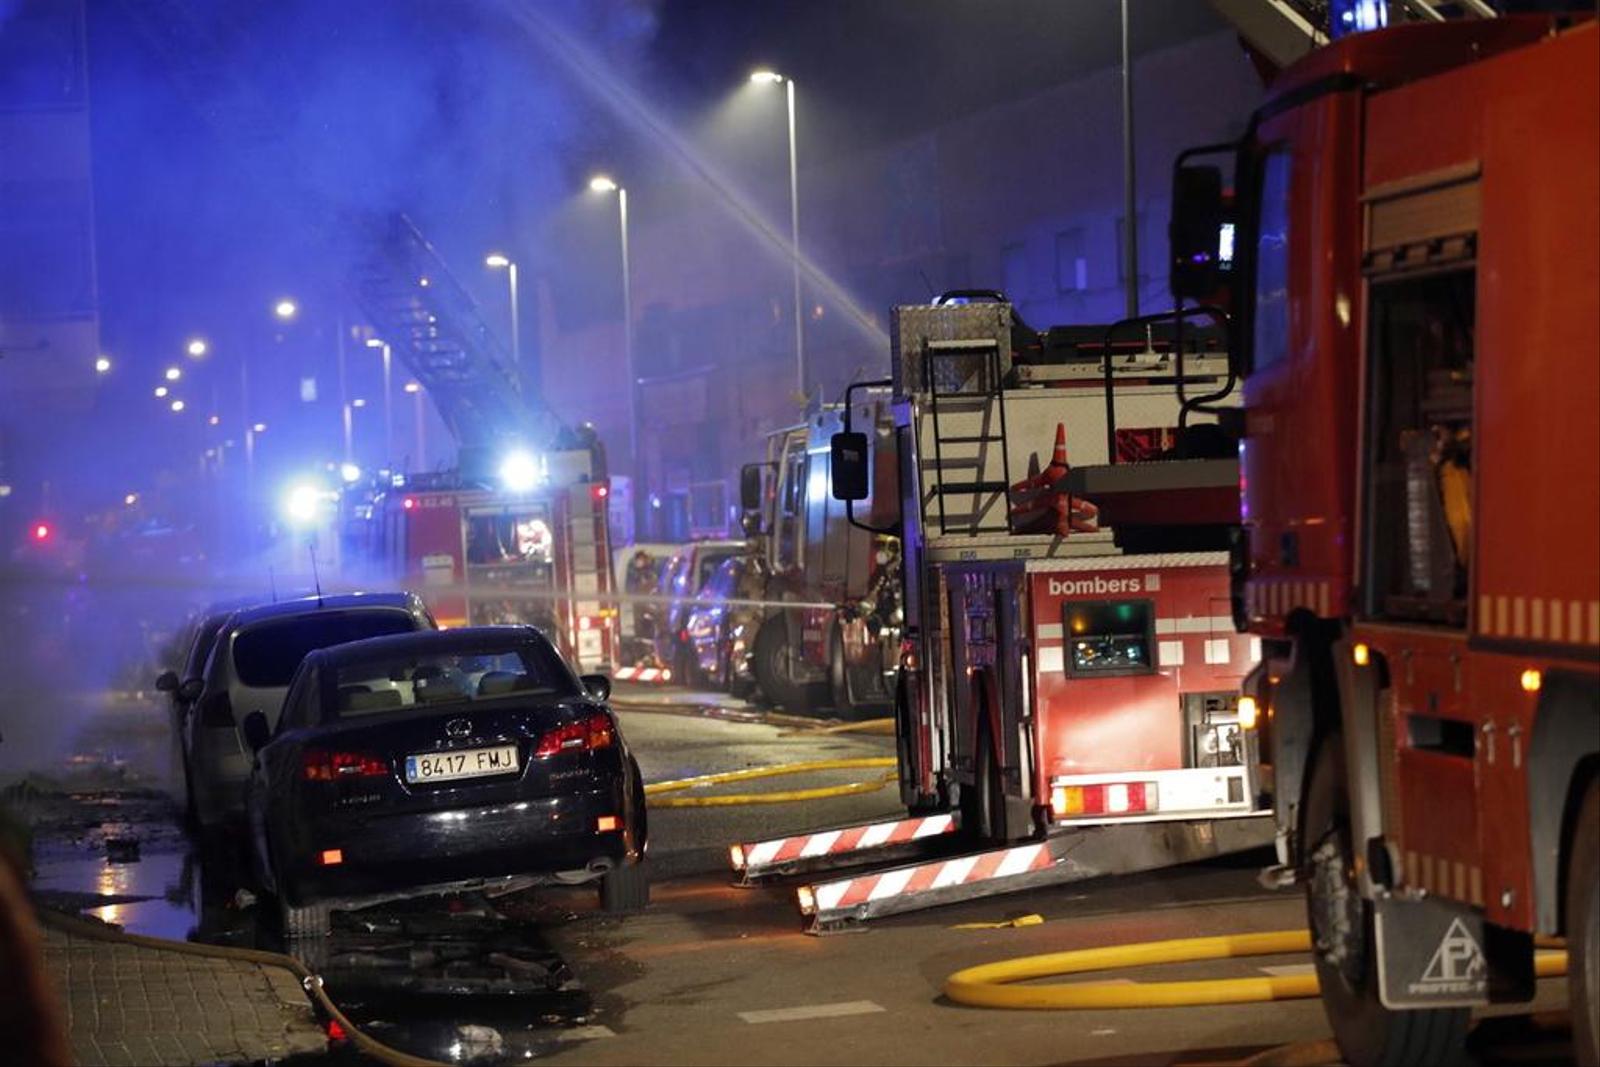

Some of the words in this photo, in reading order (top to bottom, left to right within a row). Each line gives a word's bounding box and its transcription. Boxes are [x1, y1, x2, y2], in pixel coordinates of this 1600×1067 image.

[1049, 576, 1140, 595] bombers
[421, 755, 466, 777] 8417
[476, 749, 512, 770] FMJ
